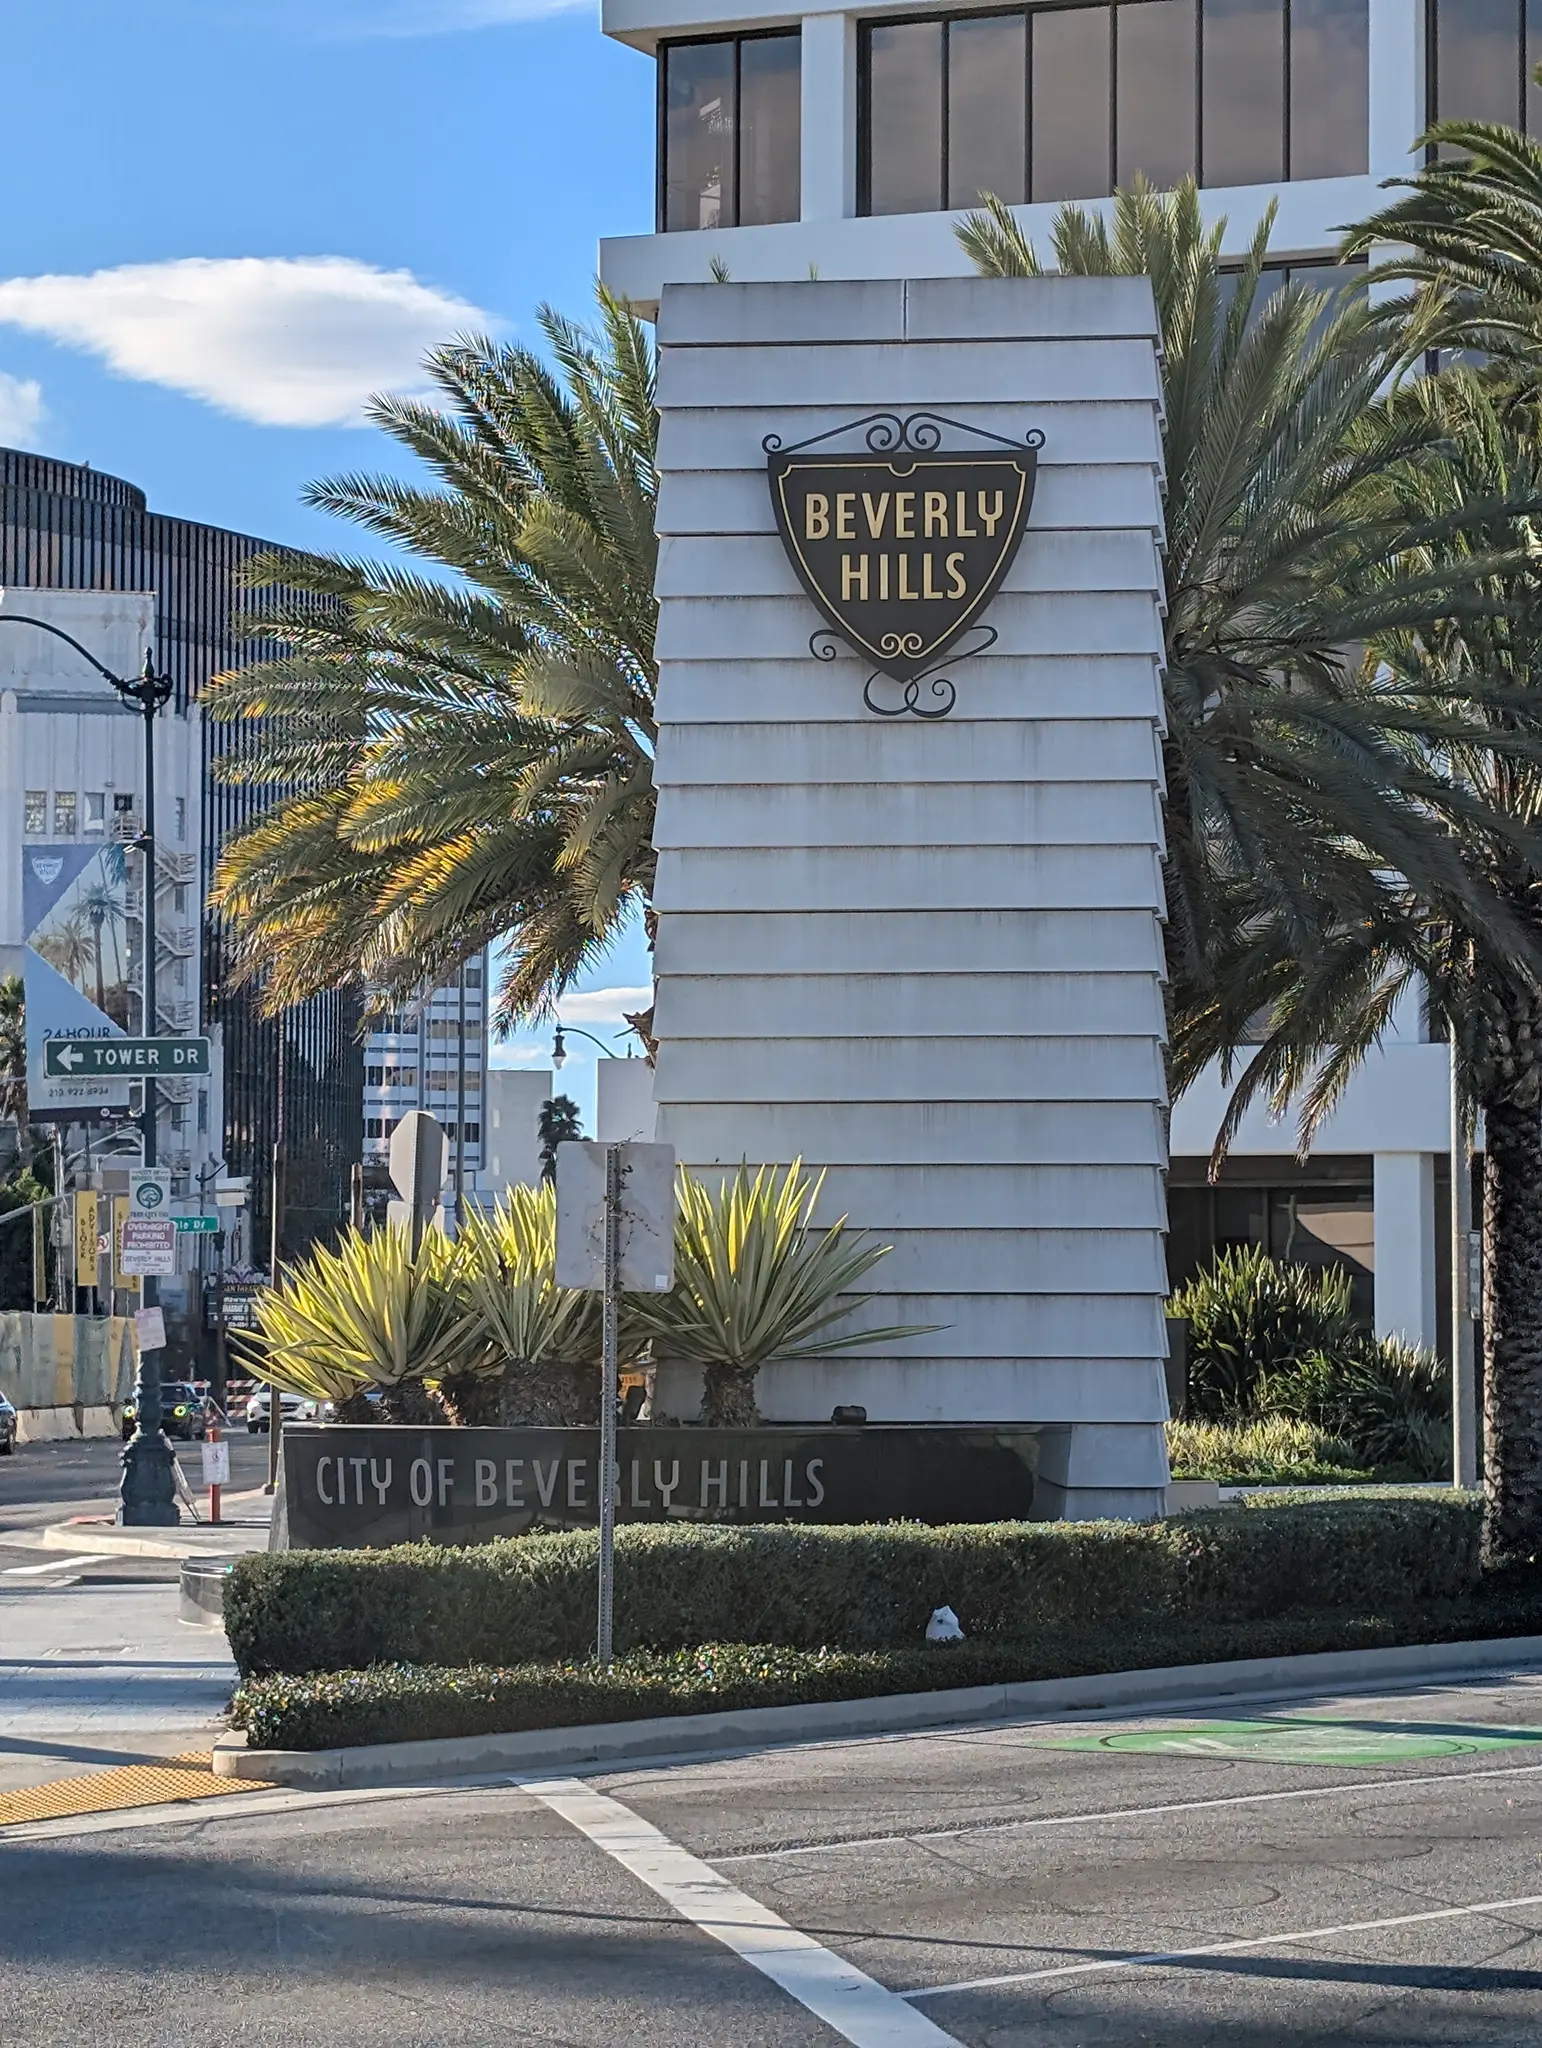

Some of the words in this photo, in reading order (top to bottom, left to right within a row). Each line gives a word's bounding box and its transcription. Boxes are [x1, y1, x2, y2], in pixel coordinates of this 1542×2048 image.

[805, 490, 1005, 540] BEVERLY
[841, 552, 968, 601] HILLS
[94, 1048, 160, 1065] TOWER
[174, 1048, 199, 1064] DR
[127, 1222, 171, 1231] OVERNIGHT
[132, 1232, 166, 1240] PARKING
[126, 1241, 170, 1249] PROHIBITED
[316, 1456, 393, 1506] CITY
[409, 1457, 454, 1506] OF
[700, 1458, 825, 1508] HILLS
